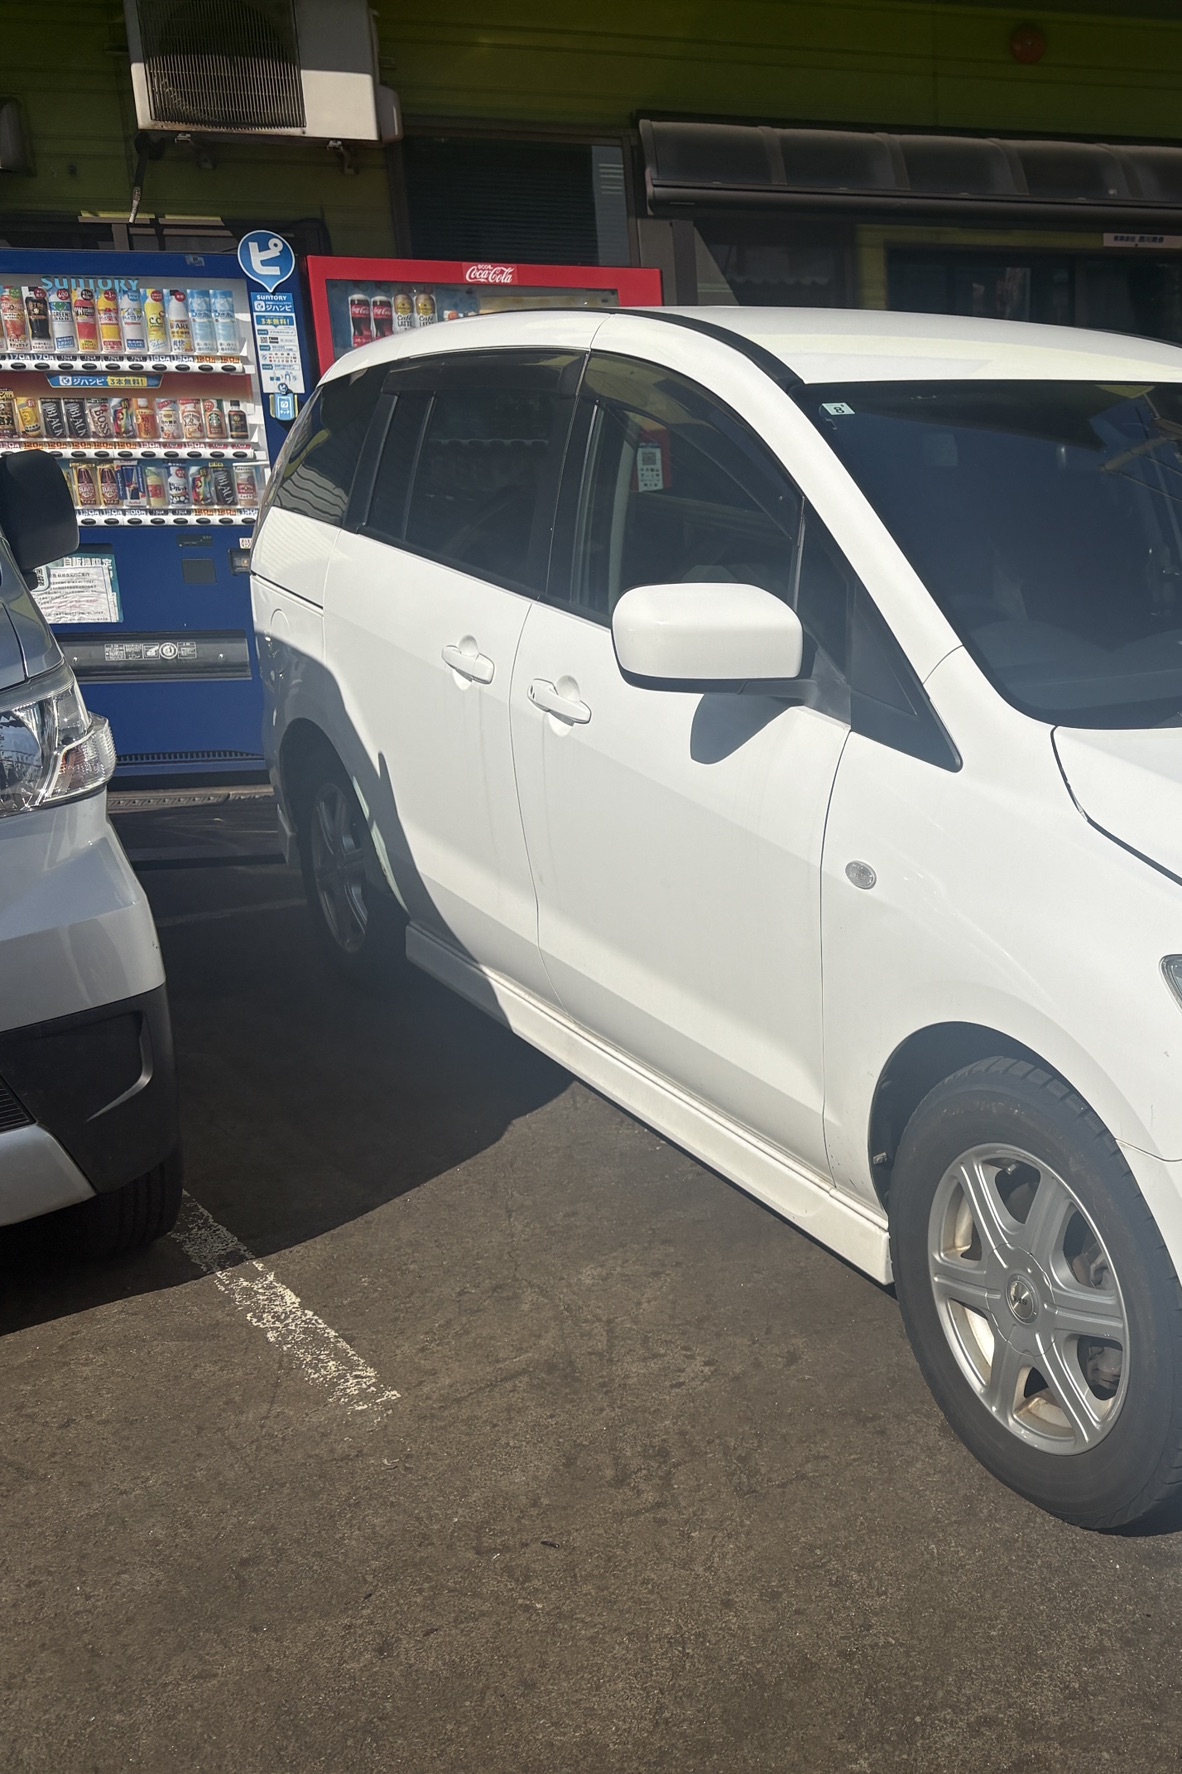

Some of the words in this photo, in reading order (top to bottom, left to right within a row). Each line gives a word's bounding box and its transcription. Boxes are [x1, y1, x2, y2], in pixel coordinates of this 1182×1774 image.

[248, 238, 284, 275] ピ
[466, 266, 514, 283] Coca-Cola
[73, 378, 104, 386] ジハンピ
